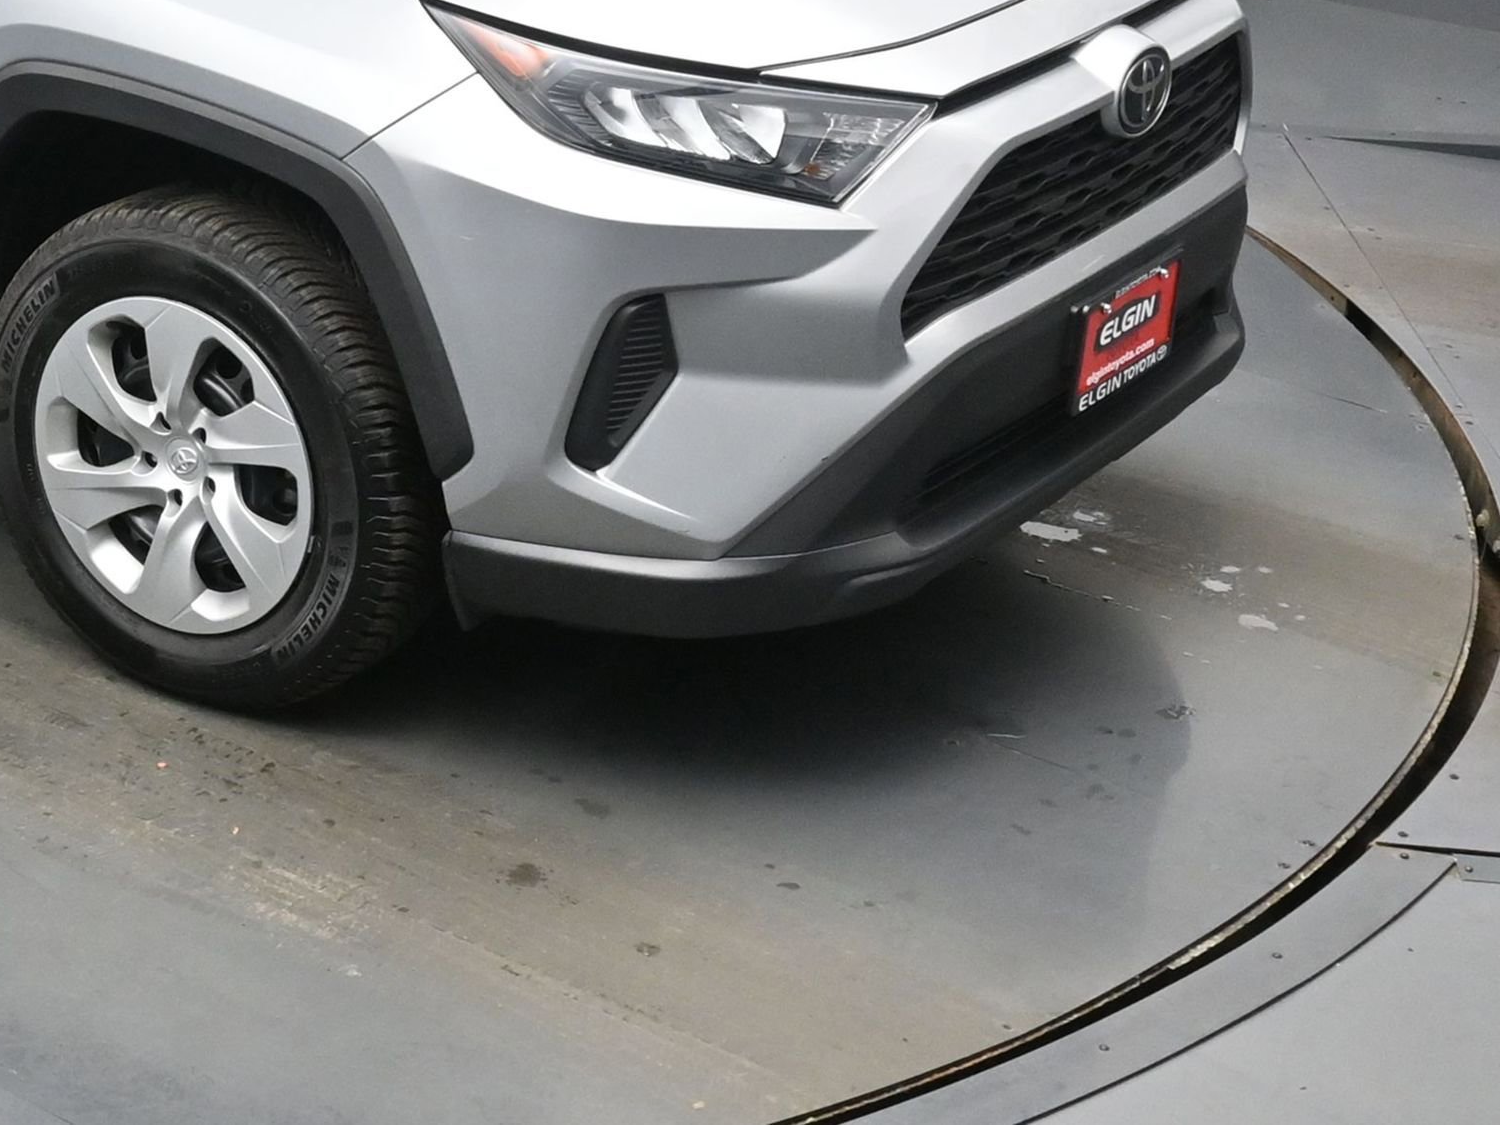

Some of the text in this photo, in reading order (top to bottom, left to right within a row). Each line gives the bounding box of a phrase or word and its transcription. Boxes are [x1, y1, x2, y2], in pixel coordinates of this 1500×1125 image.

[0, 280, 56, 374] MICHELIN
[1100, 294, 1156, 346] ELGIN
[1078, 352, 1157, 412] ELGIN TOYOTA
[1086, 338, 1155, 386] elgintoyota.com
[276, 573, 341, 658] MICHELIN
